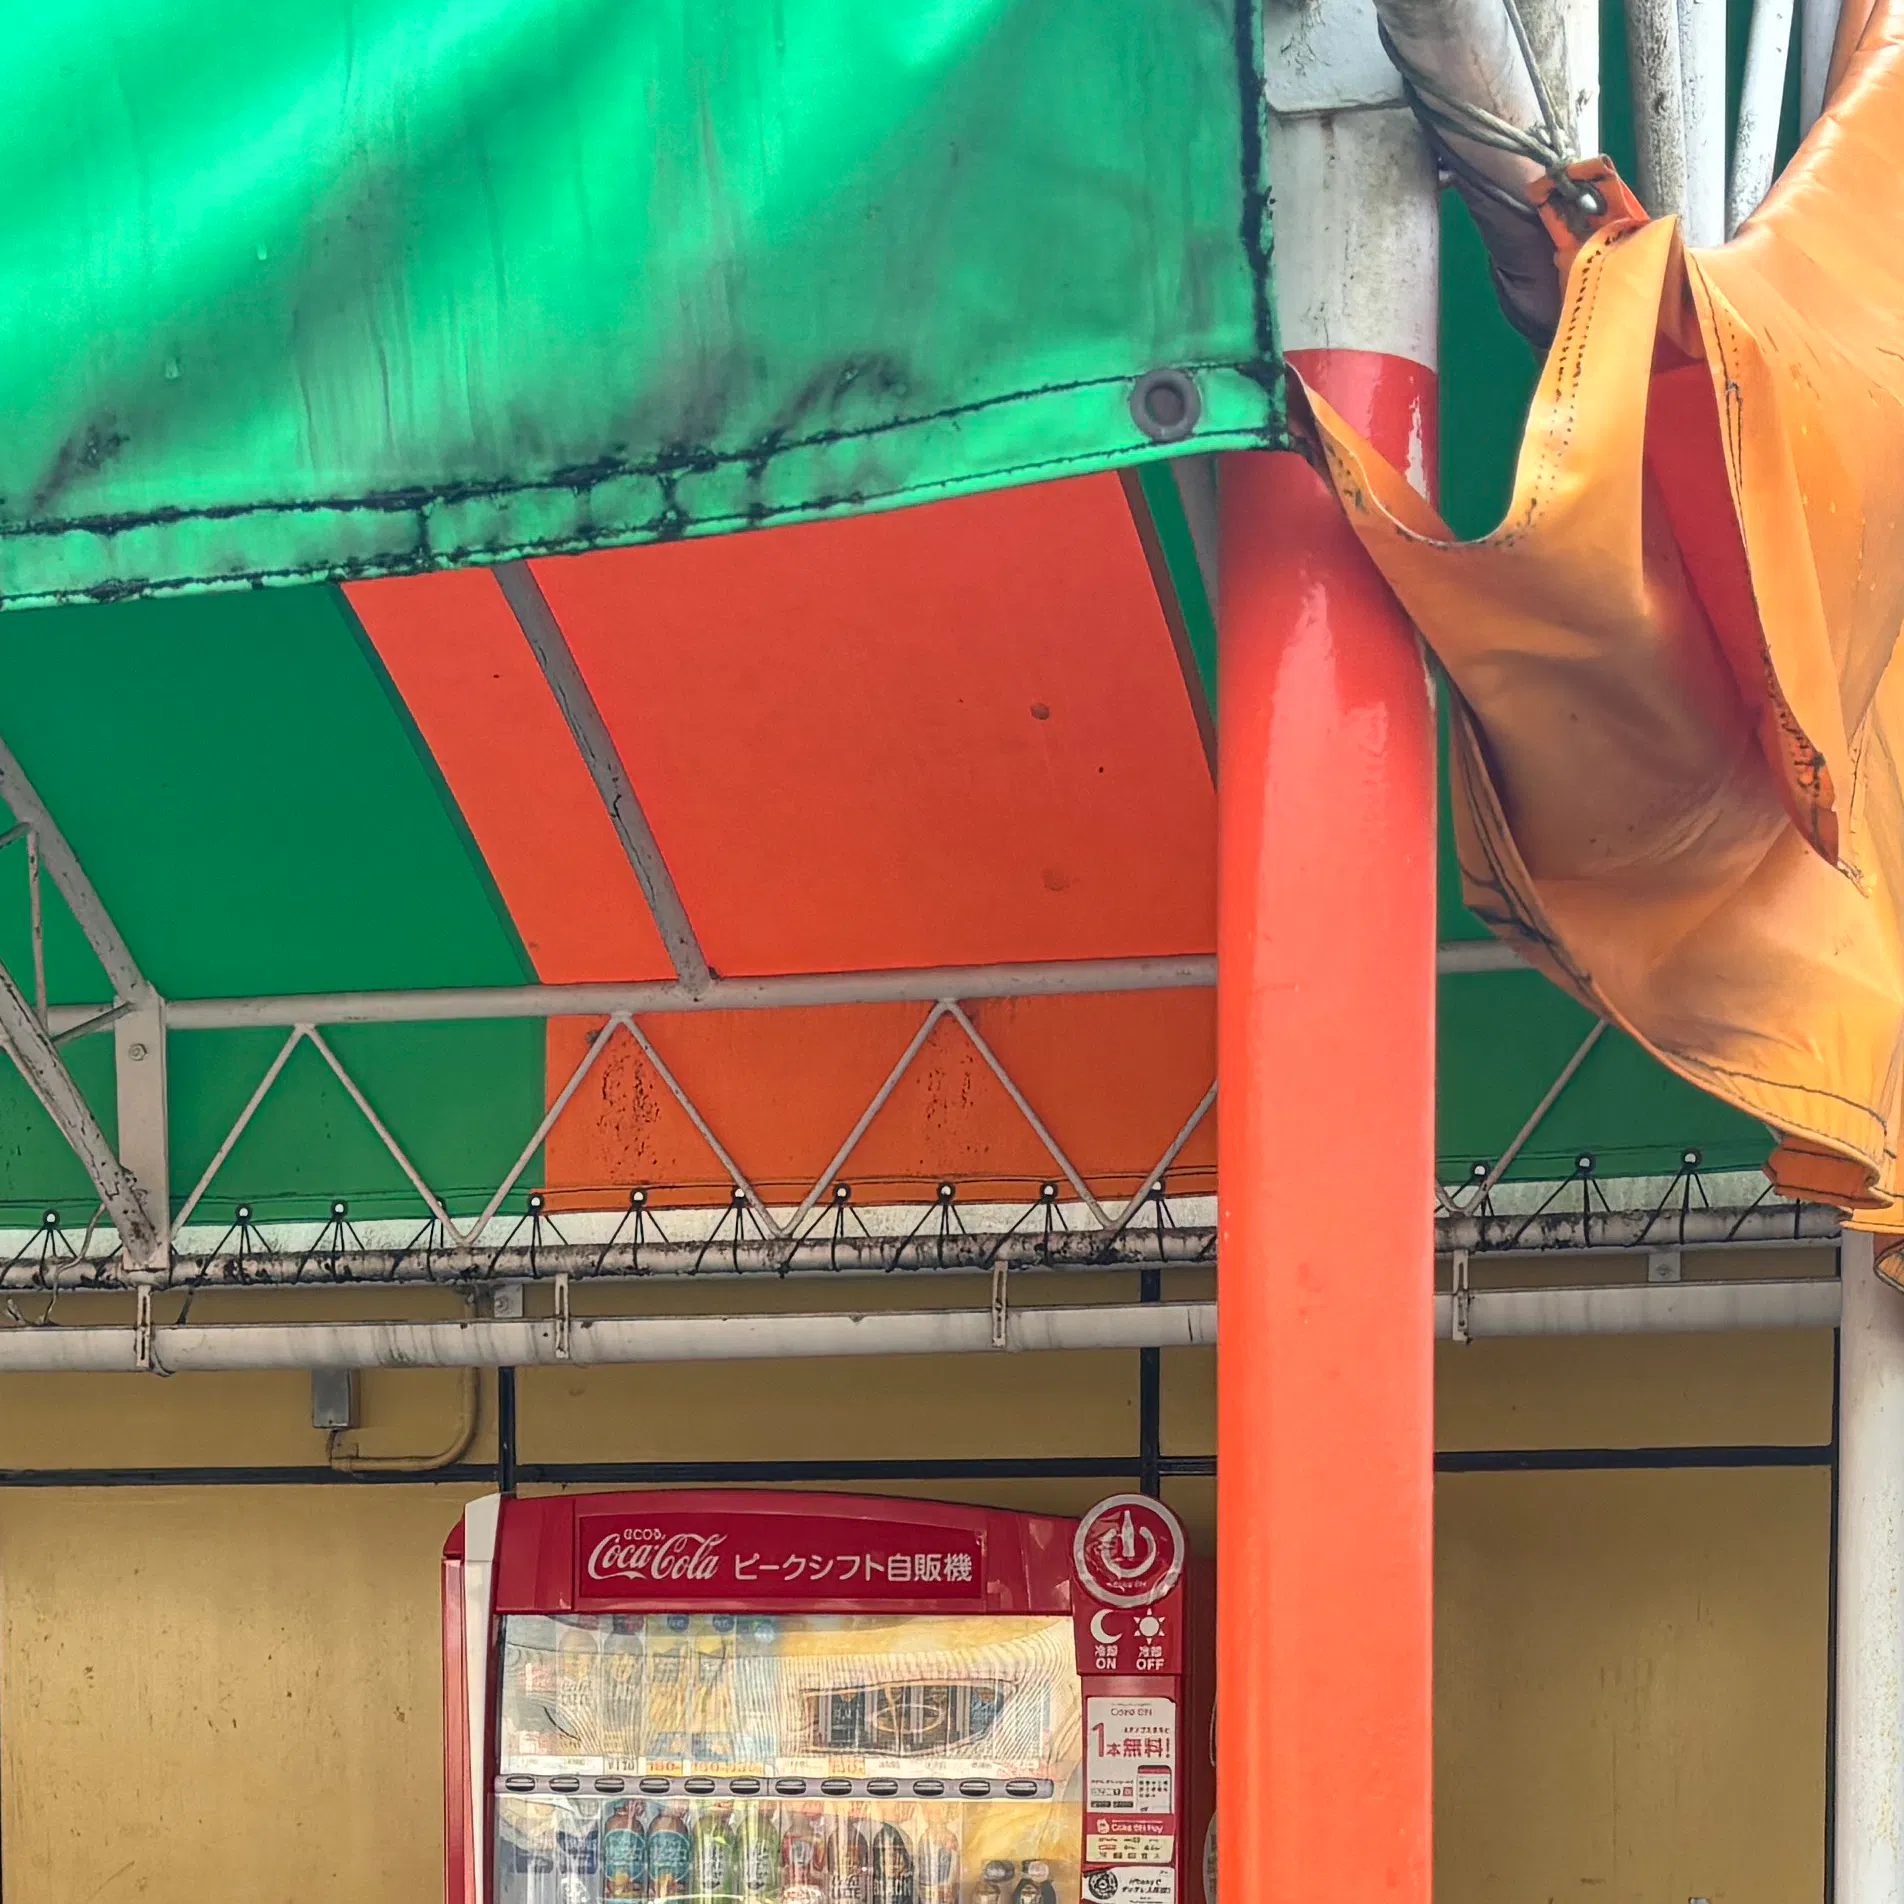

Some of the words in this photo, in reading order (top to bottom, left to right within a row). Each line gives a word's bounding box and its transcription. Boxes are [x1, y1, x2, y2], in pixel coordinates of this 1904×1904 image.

[588, 1530, 727, 1580] Coca-Cola
[735, 1553, 974, 1583] ピークシフト自販機
[1096, 1658, 1116, 1670] ON
[1136, 1659, 1164, 1671] OFF
